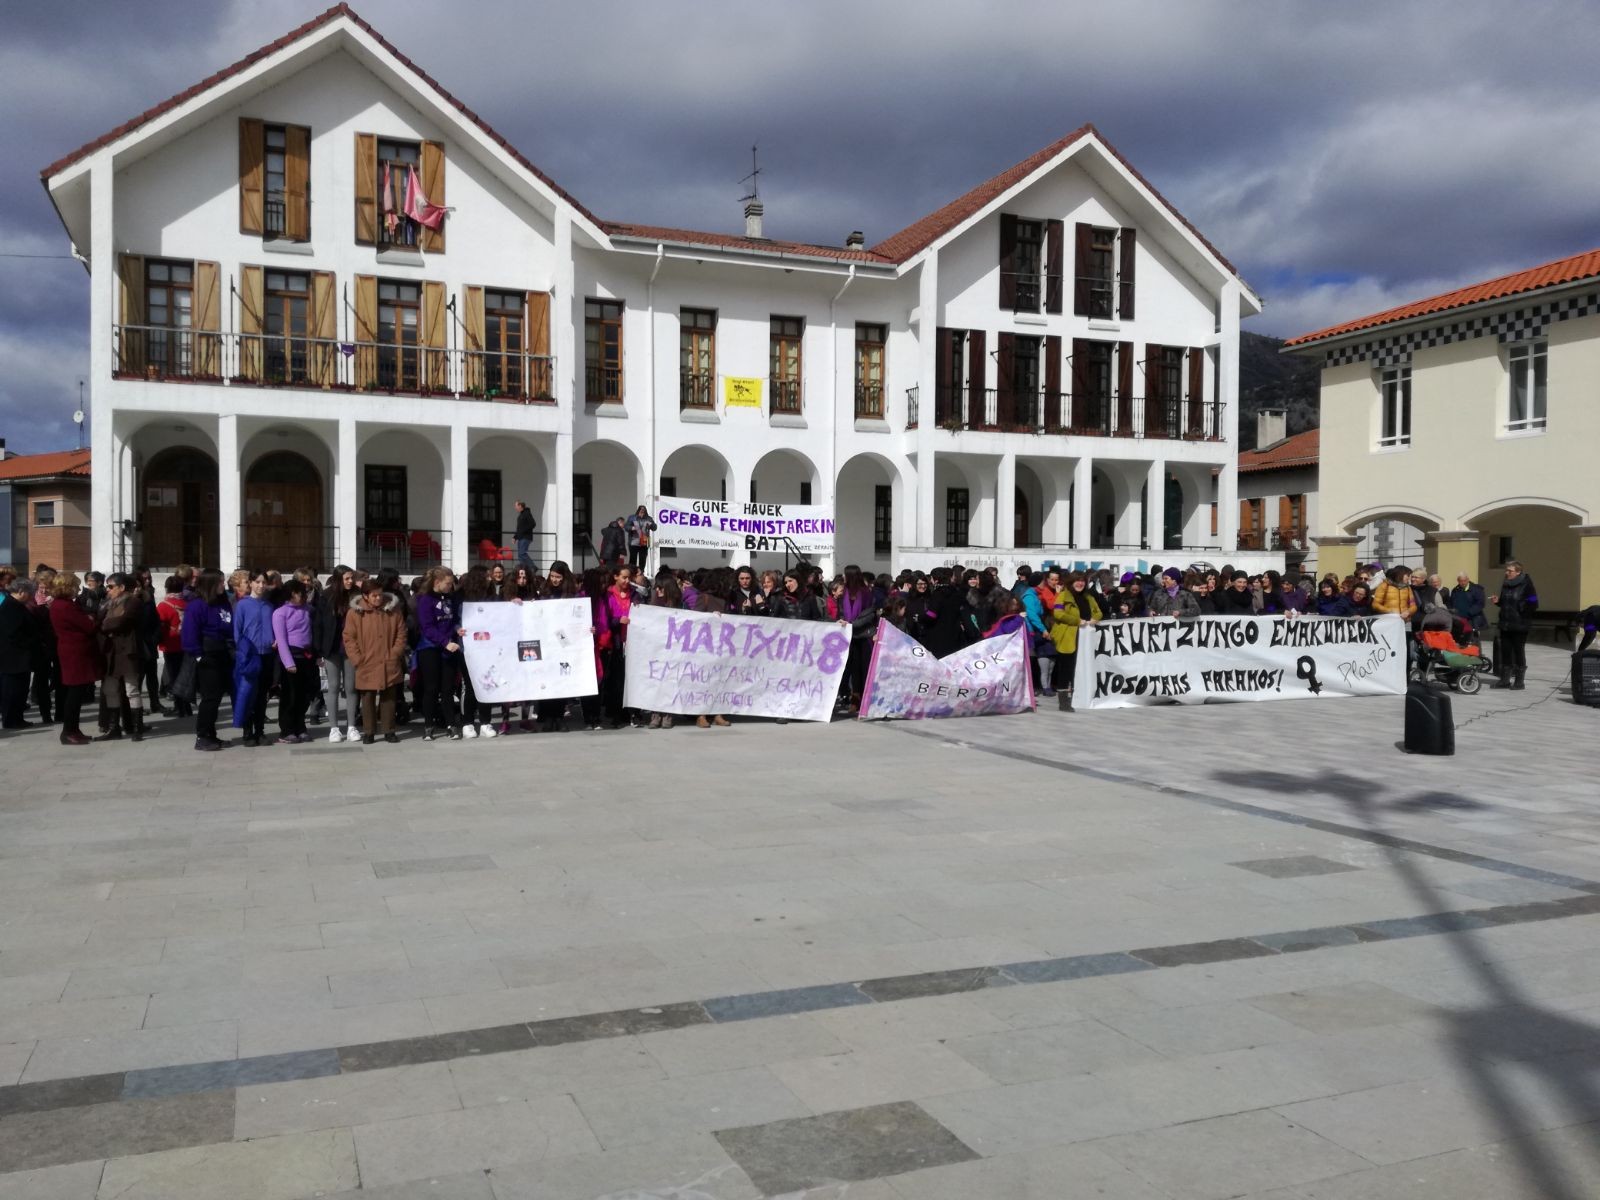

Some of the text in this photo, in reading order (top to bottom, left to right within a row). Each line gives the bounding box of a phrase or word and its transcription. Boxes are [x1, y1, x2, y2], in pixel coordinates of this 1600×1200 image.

[658, 509, 835, 535] GREBA FEMINISTAREKIN
[692, 501, 783, 517] GUNE HAUEK
[744, 535, 783, 551] BAT
[1094, 618, 1380, 659] IRURTZUNGO EMAKUMEOK
[816, 631, 850, 675] 8
[1094, 669, 1285, 699] NOSOTRAS PARAMOS!
